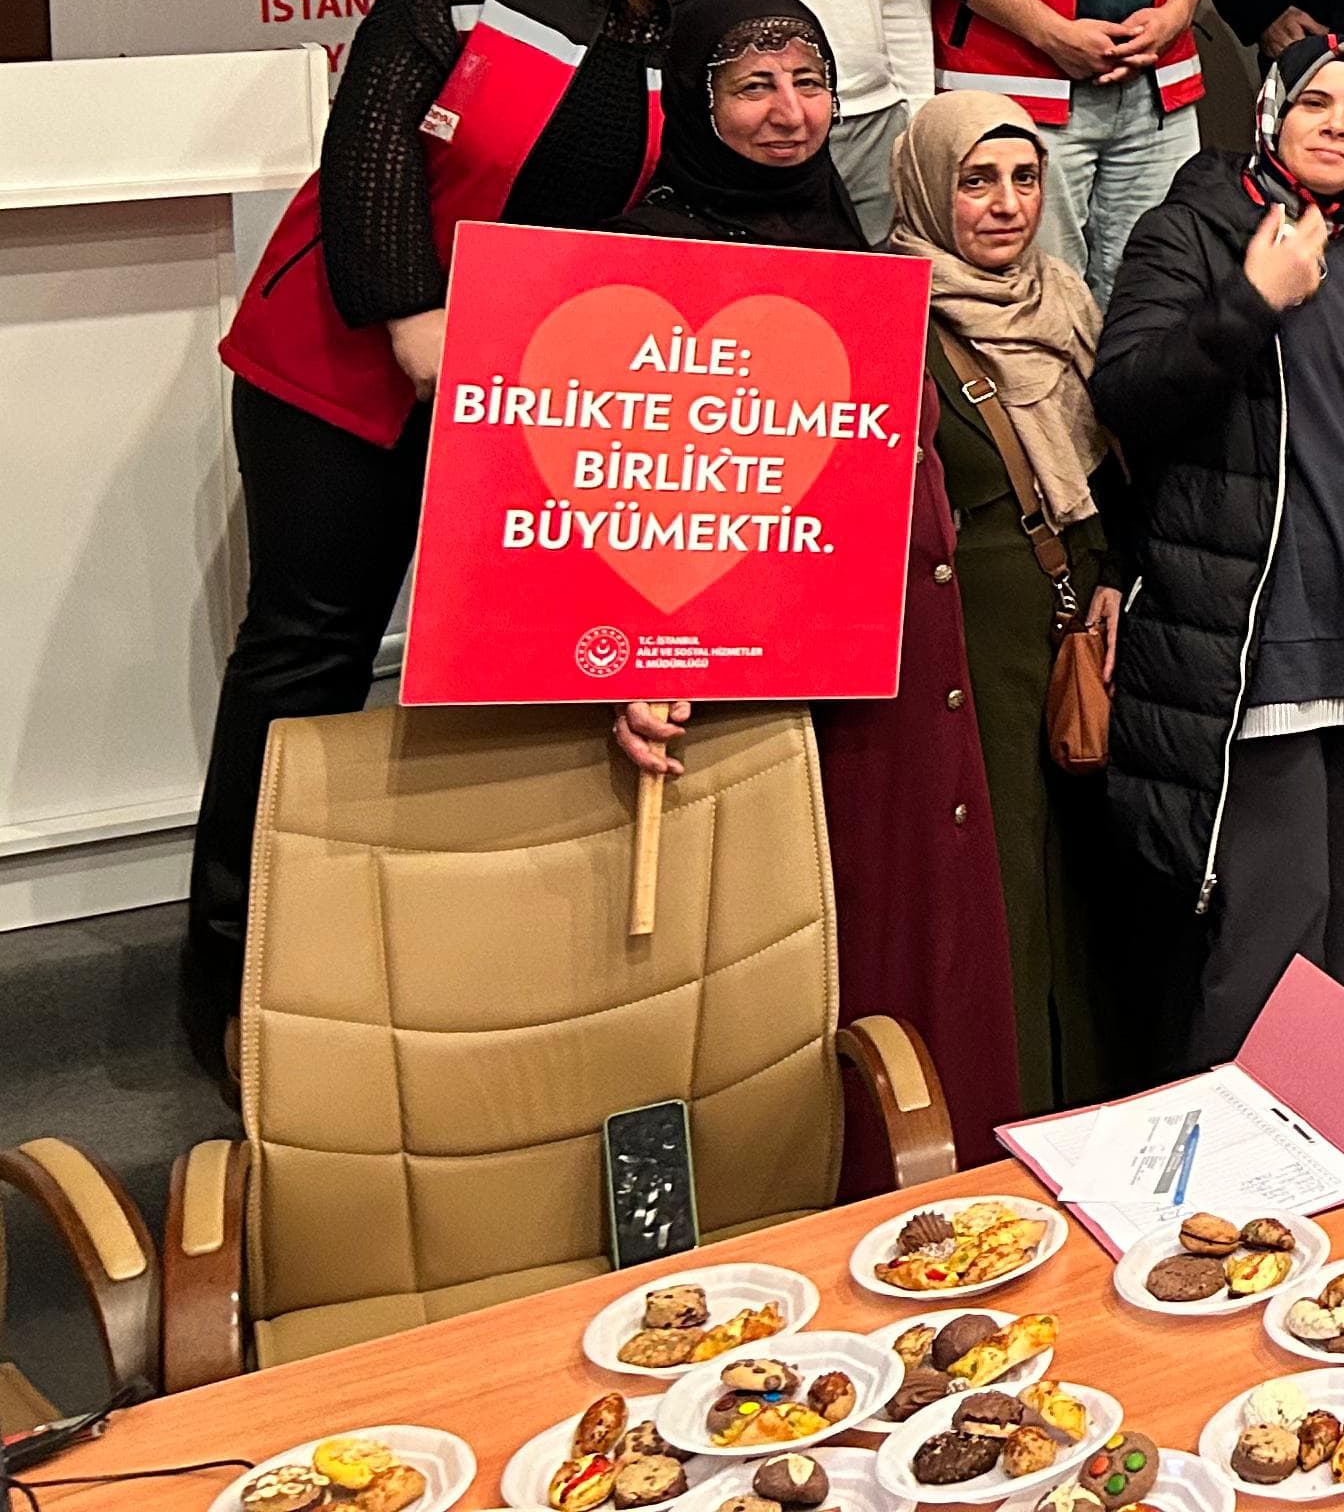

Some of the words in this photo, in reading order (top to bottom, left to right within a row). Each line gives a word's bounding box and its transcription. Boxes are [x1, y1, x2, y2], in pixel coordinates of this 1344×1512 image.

[629, 325, 752, 377] AİLE:
[453, 375, 674, 432] BİRLİKTE
[688, 388, 901, 448] GÜLMEK,
[573, 441, 786, 494] BİRLİKTE
[503, 499, 835, 554] BÜYÜMEKTİR.
